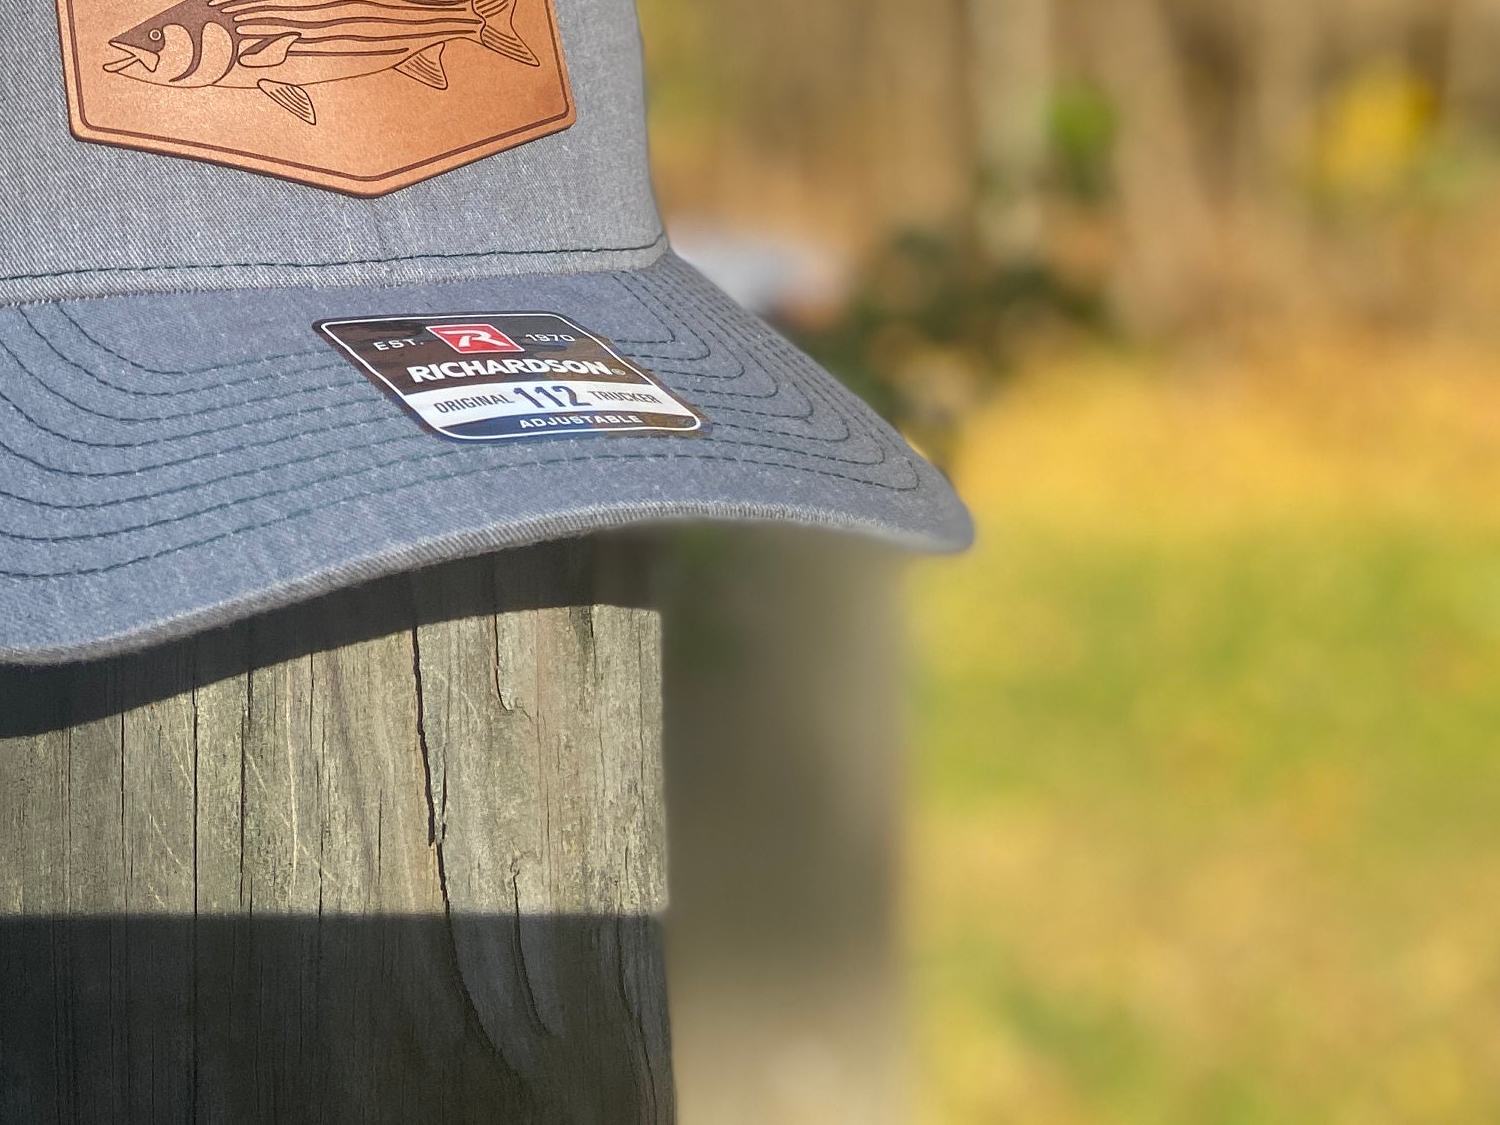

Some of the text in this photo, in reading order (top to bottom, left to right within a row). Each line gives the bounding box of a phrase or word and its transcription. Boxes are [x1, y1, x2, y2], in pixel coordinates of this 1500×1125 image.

[373, 332, 576, 351] EST. 1970
[406, 358, 614, 383] RICHARDSON
[433, 385, 662, 414] ORIGINAL 112 TRUCKER
[518, 413, 643, 429] ADJUSTABLE
